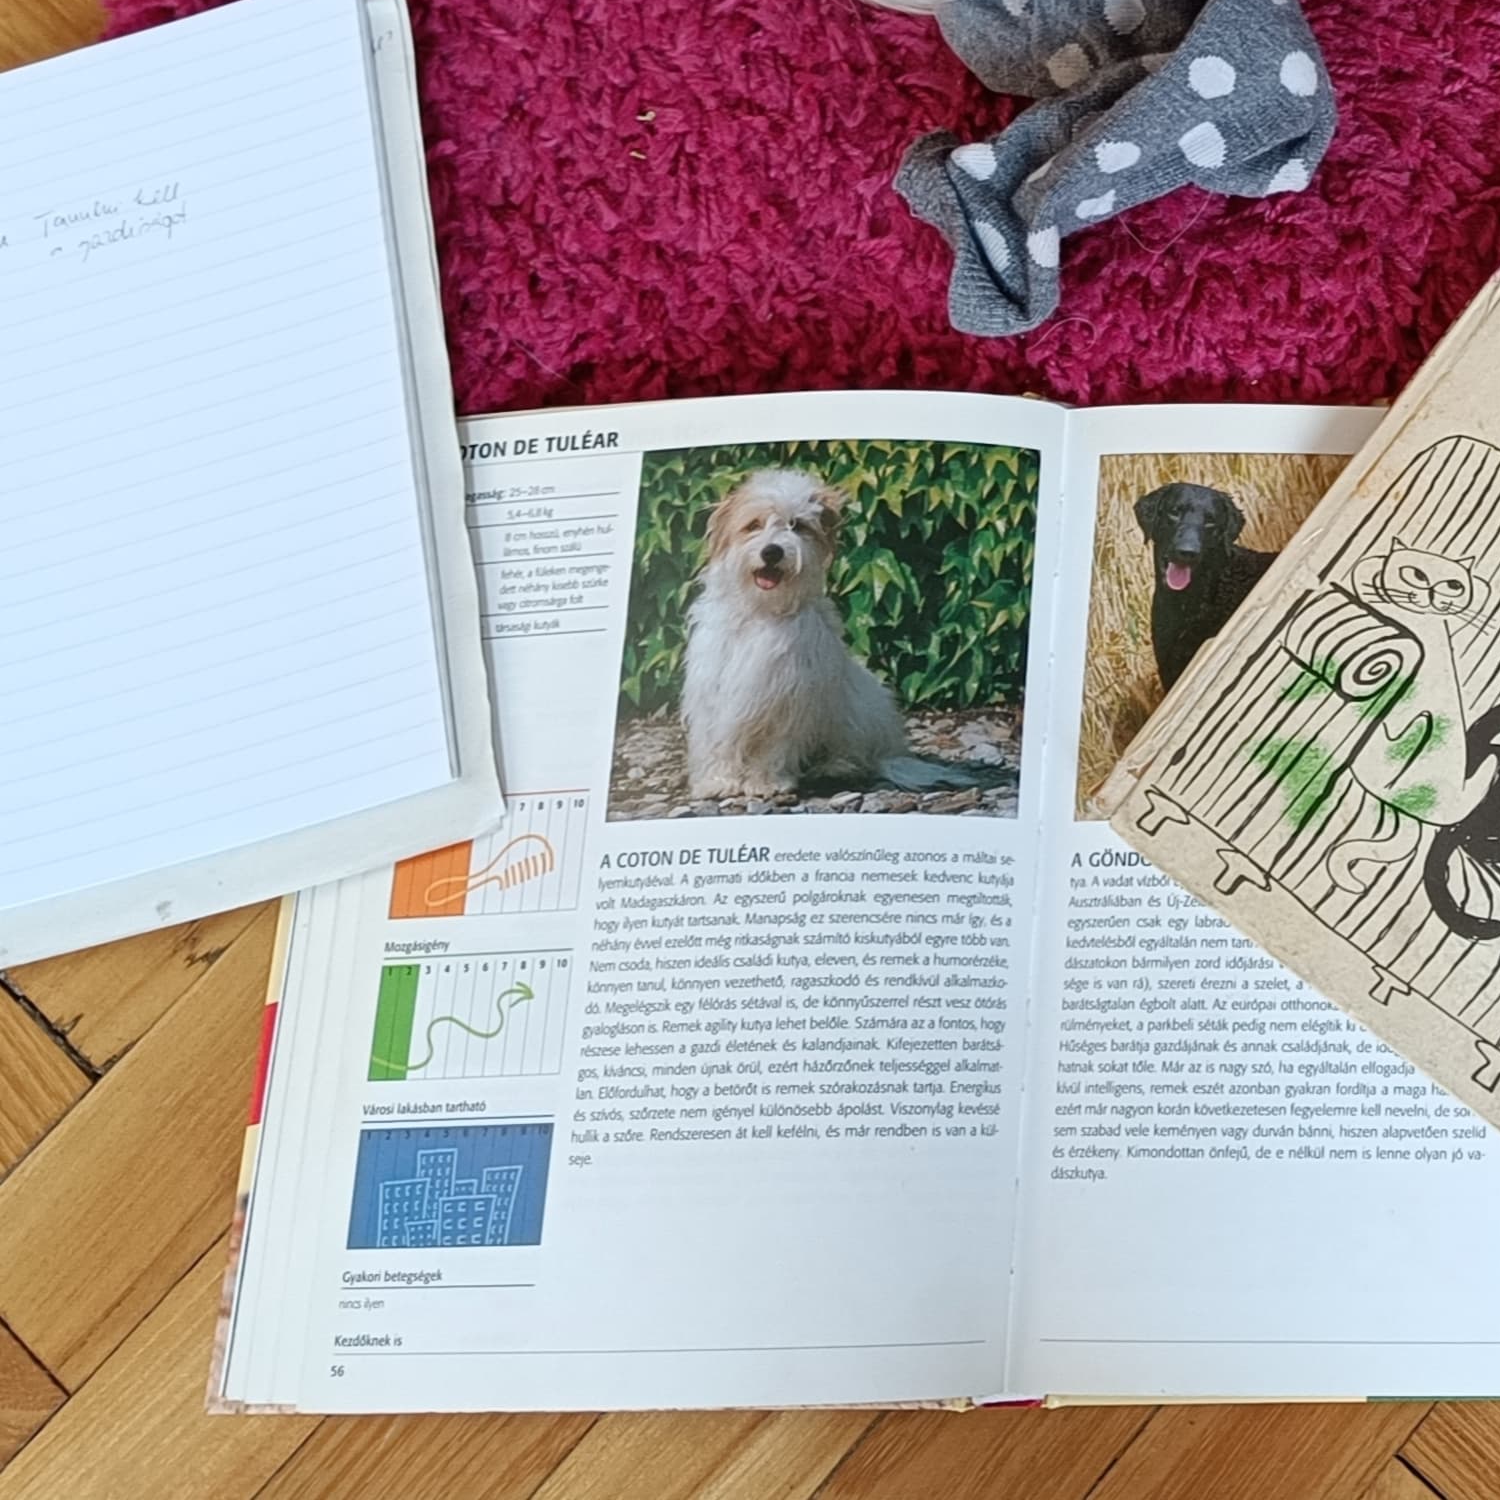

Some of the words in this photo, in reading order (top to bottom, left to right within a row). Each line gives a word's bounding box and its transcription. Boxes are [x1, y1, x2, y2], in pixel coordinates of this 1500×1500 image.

[513, 438, 539, 456] DE
[546, 430, 619, 453] TULÉAR
[519, 802, 525, 812] 7
[556, 800, 563, 809] 9
[574, 798, 584, 808] 10
[616, 849, 674, 869] COTON
[679, 849, 702, 865] DE
[706, 844, 770, 865] TULÉAR
[774, 847, 821, 864] eredete
[903, 852, 948, 864] azonos
[693, 868, 744, 889] gyarmati
[747, 867, 796, 884] időkben
[814, 867, 856, 883] francia
[861, 867, 919, 884] nemesek
[923, 868, 974, 885] kedvenc
[1070, 873, 1088, 893] tya.
[1102, 872, 1134, 889] vadat
[595, 894, 616, 911] volt
[620, 890, 708, 914] Madagaszkáron.
[712, 890, 728, 906] Az
[734, 888, 787, 909] egyszerű
[792, 888, 868, 908] polgároknak
[873, 892, 940, 909] egyenesen
[594, 914, 621, 935] hogy
[622, 913, 648, 934] ilyen
[651, 912, 685, 933] kutyát
[687, 910, 741, 928] tartsanak.
[744, 909, 807, 930] Manapság
[809, 913, 826, 925] ez
[828, 909, 902, 926] szerencsére
[905, 910, 938, 926] nincs
[941, 910, 966, 927] már
[968, 911, 987, 931] így,
[990, 912, 1003, 928] és
[384, 940, 450, 955] Mozgásigény
[425, 965, 431, 975] 3
[444, 965, 450, 973] 4
[464, 964, 470, 973] 5
[482, 963, 489, 972] 6
[502, 961, 508, 971] 7
[520, 960, 526, 970] 8
[539, 960, 546, 969] 9
[556, 959, 568, 968] 10
[362, 1104, 394, 1116] Városi
[397, 1102, 443, 1115] lakásban
[445, 1100, 486, 1113] tartható
[1055, 1101, 1082, 1117] ezért
[1084, 1101, 1108, 1117] már
[1110, 1105, 1154, 1121] nagyon
[1157, 1101, 1191, 1117] korán
[1194, 1101, 1287, 1118] következetesen
[1290, 1102, 1358, 1122] fegyelemre
[1361, 1102, 1381, 1118] kell
[1384, 1102, 1431, 1122] nevelni,
[1434, 1102, 1452, 1118] de
[1053, 1126, 1077, 1138] sem
[1080, 1122, 1122, 1138] szabad
[1124, 1122, 1150, 1138] vele
[1152, 1122, 1217, 1142] keményen
[1220, 1126, 1249, 1143] vagy
[1252, 1123, 1294, 1139] durván
[1298, 1123, 1335, 1143] bánni,
[1339, 1123, 1378, 1139] hiszen
[1381, 1123, 1448, 1143] alapvetően
[1452, 1123, 1486, 1139] szelíd
[1052, 1144, 1065, 1160] és
[1068, 1144, 1122, 1164] érzékeny.
[1126, 1144, 1205, 1160] Kimondottan
[1208, 1144, 1251, 1164] önfejű,
[1254, 1144, 1272, 1160] de
[1288, 1144, 1325, 1160] nélkül
[1329, 1148, 1358, 1161] nem
[1362, 1145, 1372, 1161] is
[1376, 1145, 1411, 1161] lenne
[1414, 1145, 1447, 1165] olyan
[1451, 1145, 1463, 1165] jó
[1467, 1149, 1485, 1161] va-
[1050, 1165, 1108, 1185] dászkutya.
[342, 1270, 381, 1285] Gyakori
[384, 1269, 443, 1285] betegségek
[334, 1333, 390, 1347] Kezdőknek
[393, 1333, 403, 1347] is
[330, 1365, 345, 1377] 56
